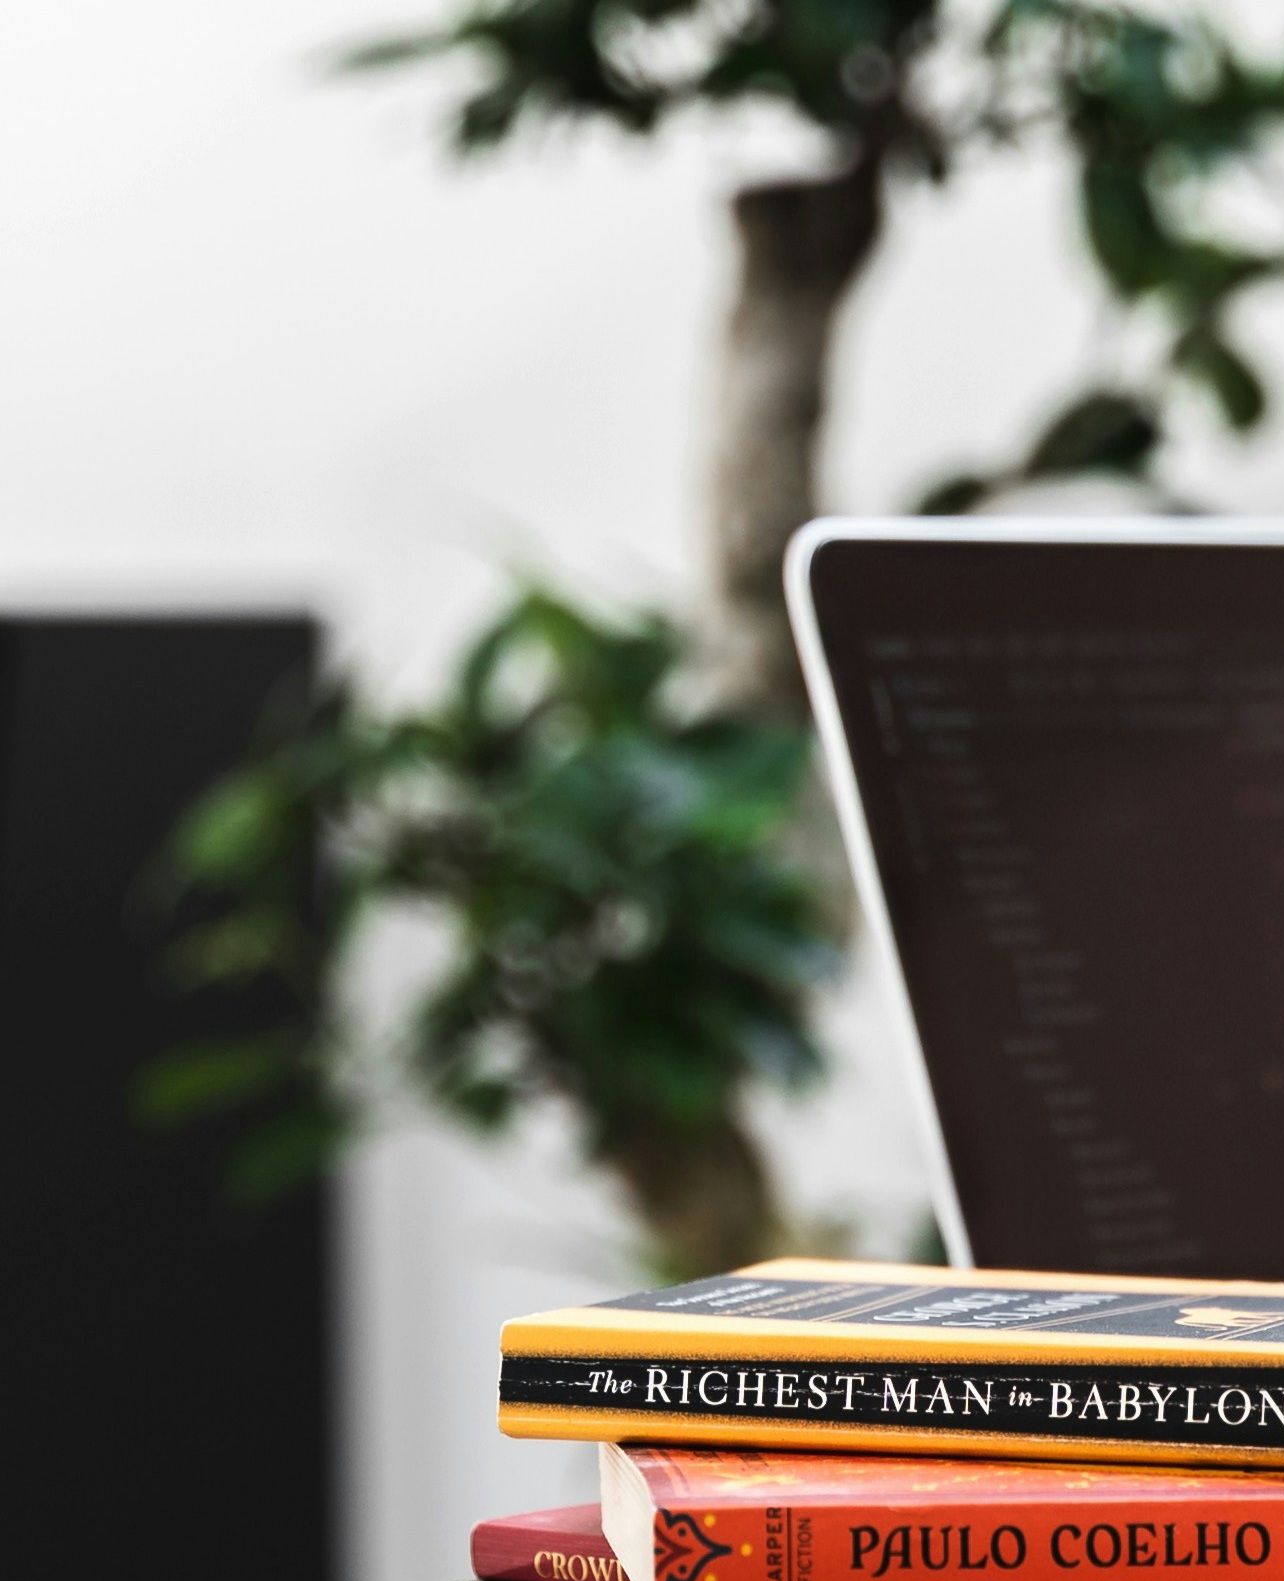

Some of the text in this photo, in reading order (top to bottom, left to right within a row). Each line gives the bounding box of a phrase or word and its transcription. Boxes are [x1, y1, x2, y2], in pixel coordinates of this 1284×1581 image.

[588, 1369, 633, 1396] The
[645, 1367, 865, 1411] RICHEST
[882, 1375, 993, 1417] MAN
[1009, 1385, 1033, 1409] in
[850, 1521, 1271, 1576] PAULO COELHO
